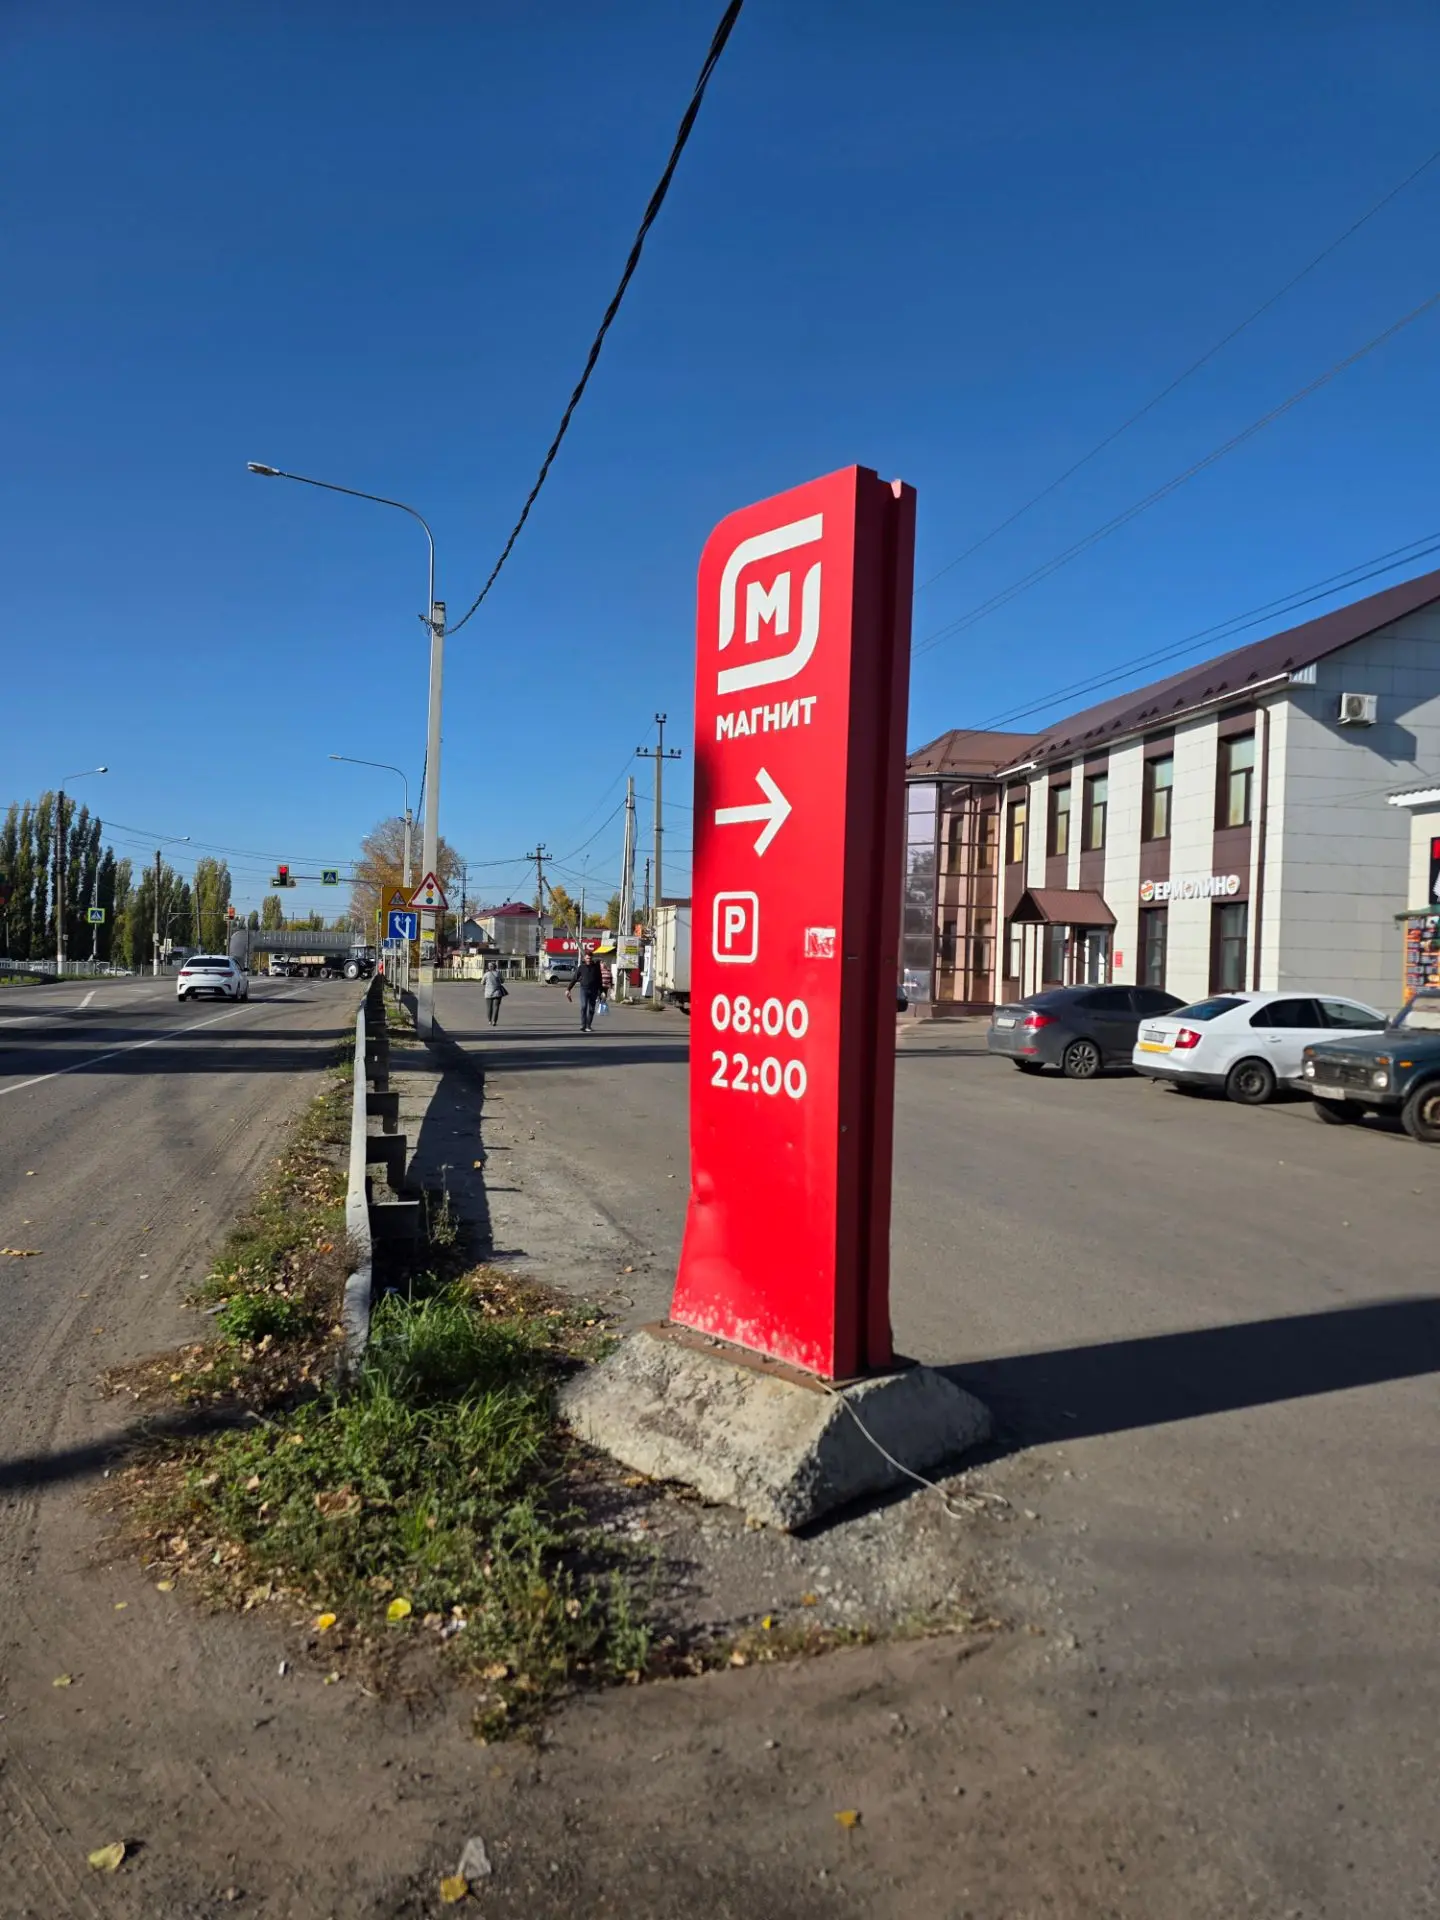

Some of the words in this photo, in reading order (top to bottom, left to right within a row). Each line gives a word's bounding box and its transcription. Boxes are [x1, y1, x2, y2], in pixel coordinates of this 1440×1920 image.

[745, 571, 791, 644] М
[715, 696, 817, 741] МАГНИТ
[1154, 874, 1240, 901] ЕРМОЛИНО
[570, 941, 595, 951] МТС
[724, 905, 746, 949] P
[711, 993, 809, 1039] 08:00
[710, 1050, 808, 1099] 22:00
